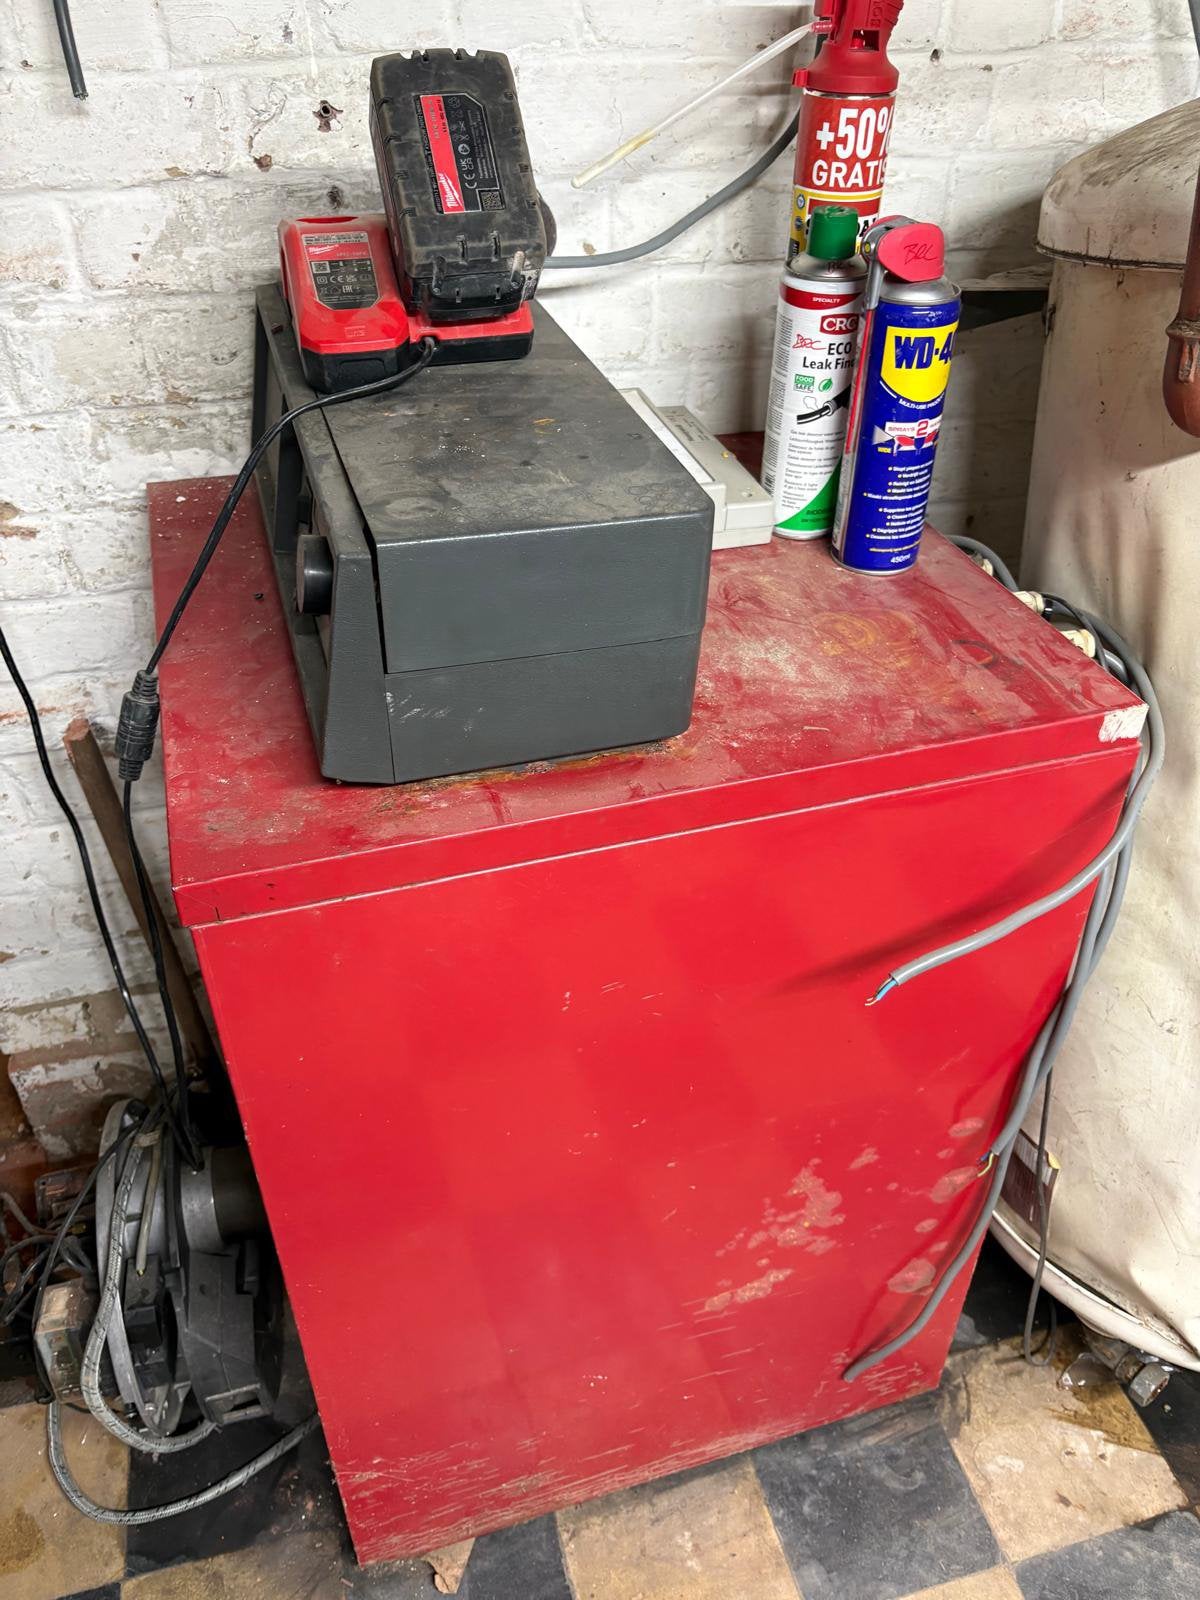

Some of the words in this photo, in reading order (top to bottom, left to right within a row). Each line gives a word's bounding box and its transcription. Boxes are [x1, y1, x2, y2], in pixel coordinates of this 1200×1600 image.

[816, 106, 894, 159] +50%
[438, 172, 459, 208] Milwaukee
[812, 296, 840, 304] SPECIALTY
[822, 316, 857, 331] CRC
[827, 342, 852, 356] ECO
[802, 356, 832, 369] Leak
[898, 398, 926, 409] MULTI-USE
[916, 420, 928, 436] 2
